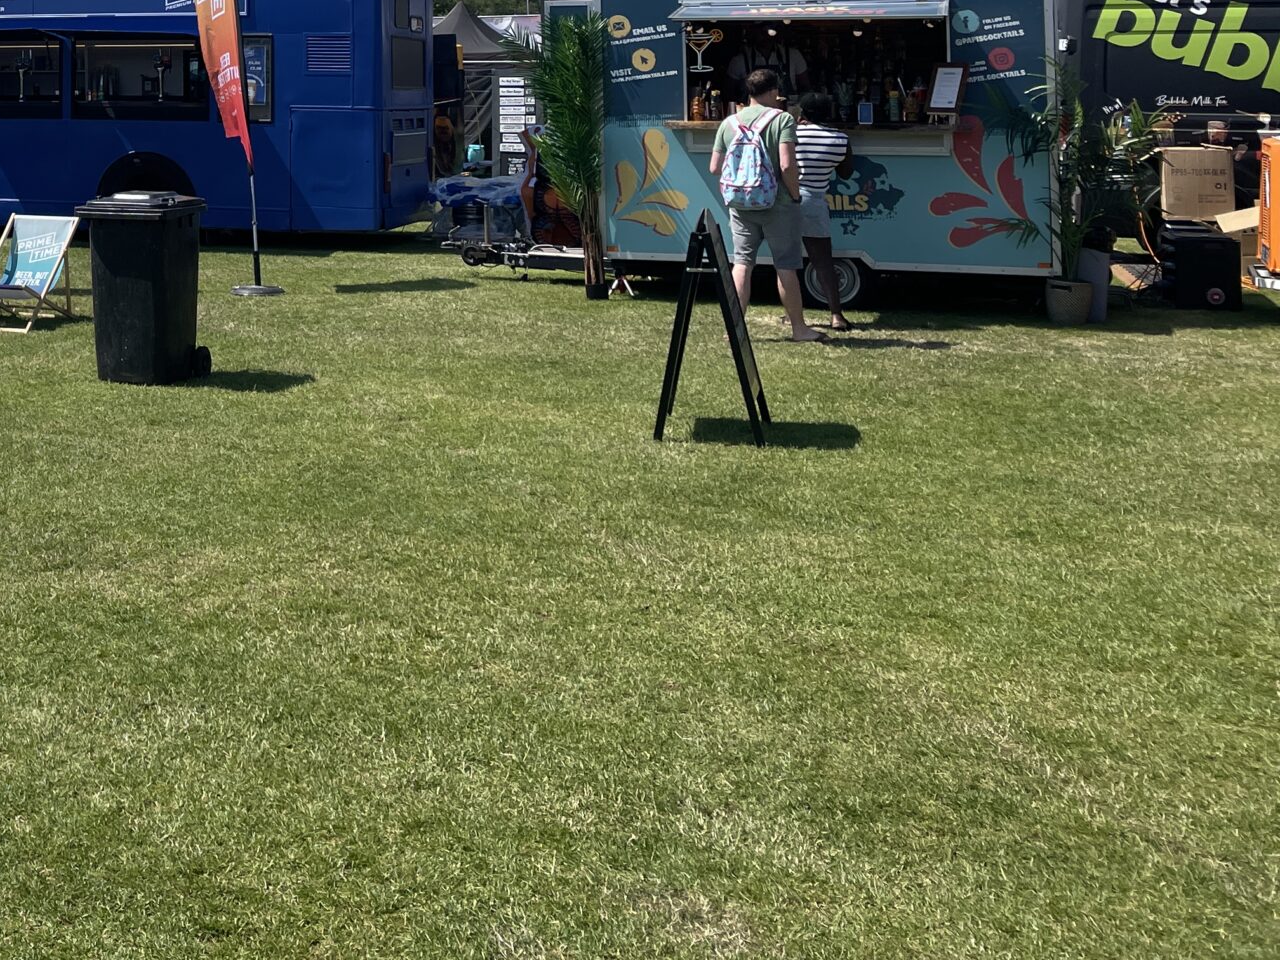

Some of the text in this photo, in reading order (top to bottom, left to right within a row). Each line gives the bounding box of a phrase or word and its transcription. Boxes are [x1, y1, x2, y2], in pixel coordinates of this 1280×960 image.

[632, 24, 668, 35] EMAIL US
[610, 67, 632, 78] VISIT
[1102, 98, 1124, 115] New!
[1155, 95, 1228, 107] Bubble Milk Tea
[17, 236, 53, 250] PRIME
[34, 245, 60, 259] TIME
